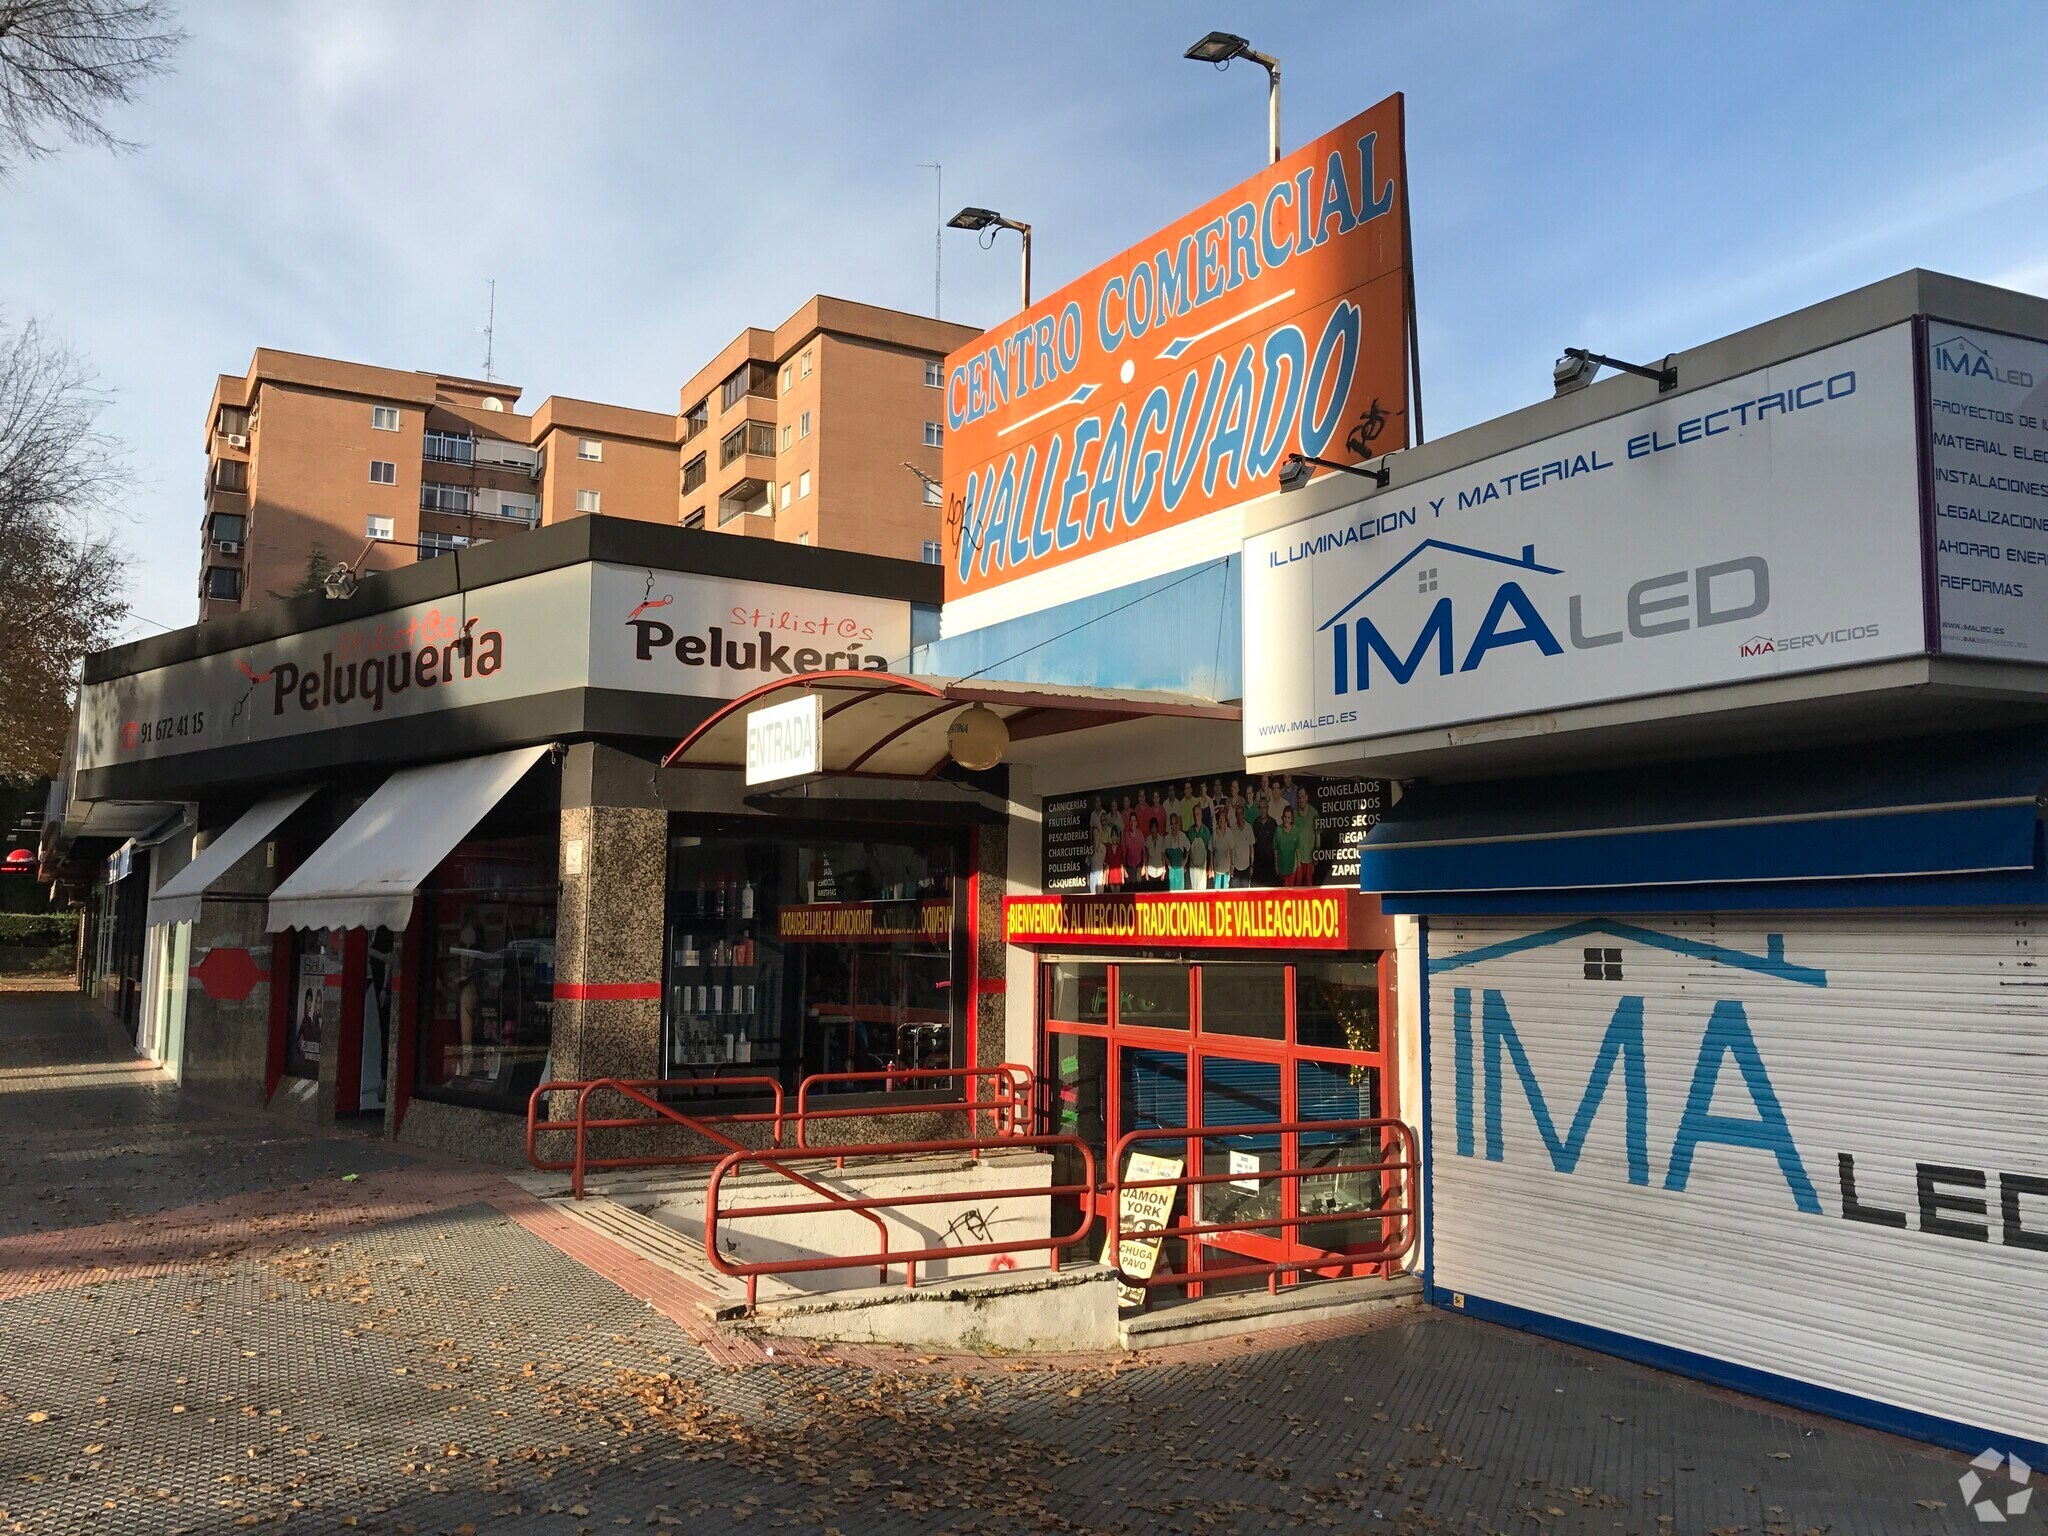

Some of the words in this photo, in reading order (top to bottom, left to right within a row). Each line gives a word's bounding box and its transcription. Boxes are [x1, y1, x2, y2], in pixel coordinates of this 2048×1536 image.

[948, 301, 1083, 432] CENTRO
[1098, 131, 1395, 354] COMERCIAL
[1932, 399, 2014, 425] PROYECTOS
[2019, 415, 2038, 429] DE
[958, 299, 1362, 584] VALLEAGUADO
[1933, 432, 2008, 457] MATERIAL
[1270, 506, 1416, 568] ILUMINACION
[1429, 497, 1445, 518] Y
[1458, 451, 1614, 511] MATERIAL
[1628, 370, 1857, 460] ELECTRICO
[1938, 540, 2000, 560] AHORRO
[1940, 574, 2024, 598] REFORMAS
[729, 606, 875, 642] Stilist@s
[269, 617, 502, 715] Peluquería
[141, 722, 151, 744] 91
[155, 717, 173, 741] 672
[177, 714, 188, 736] 41
[192, 711, 204, 735] 15
[1259, 710, 1357, 737] WWW.IMALED.ES
[748, 713, 812, 768] ENTRADA
[1317, 780, 1380, 798] CONGELADOS
[1048, 799, 1088, 813] CARNICERÍAS
[1321, 796, 1380, 813] ENCURTIDOS
[1048, 815, 1081, 828] FRUTERÍAS
[1314, 816, 1350, 830] FRUTOS
[1351, 813, 1381, 827] SECOS
[1048, 830, 1089, 843] PESCADERÍAS
[1048, 845, 1094, 858] CHARCUTERÍAS
[1048, 862, 1081, 873] POLLERÍAS
[1048, 876, 1087, 889] CASQUERÍAS
[1070, 903, 1083, 934] AL
[1084, 902, 1136, 936] MERCADO
[1136, 901, 1214, 937] TRADICIONAL
[1215, 901, 1233, 937] DE
[1233, 898, 1339, 938] VALLEAGUADO!
[1127, 1200, 1163, 1219] YORK
[1122, 1257, 1147, 1270] PAVO
